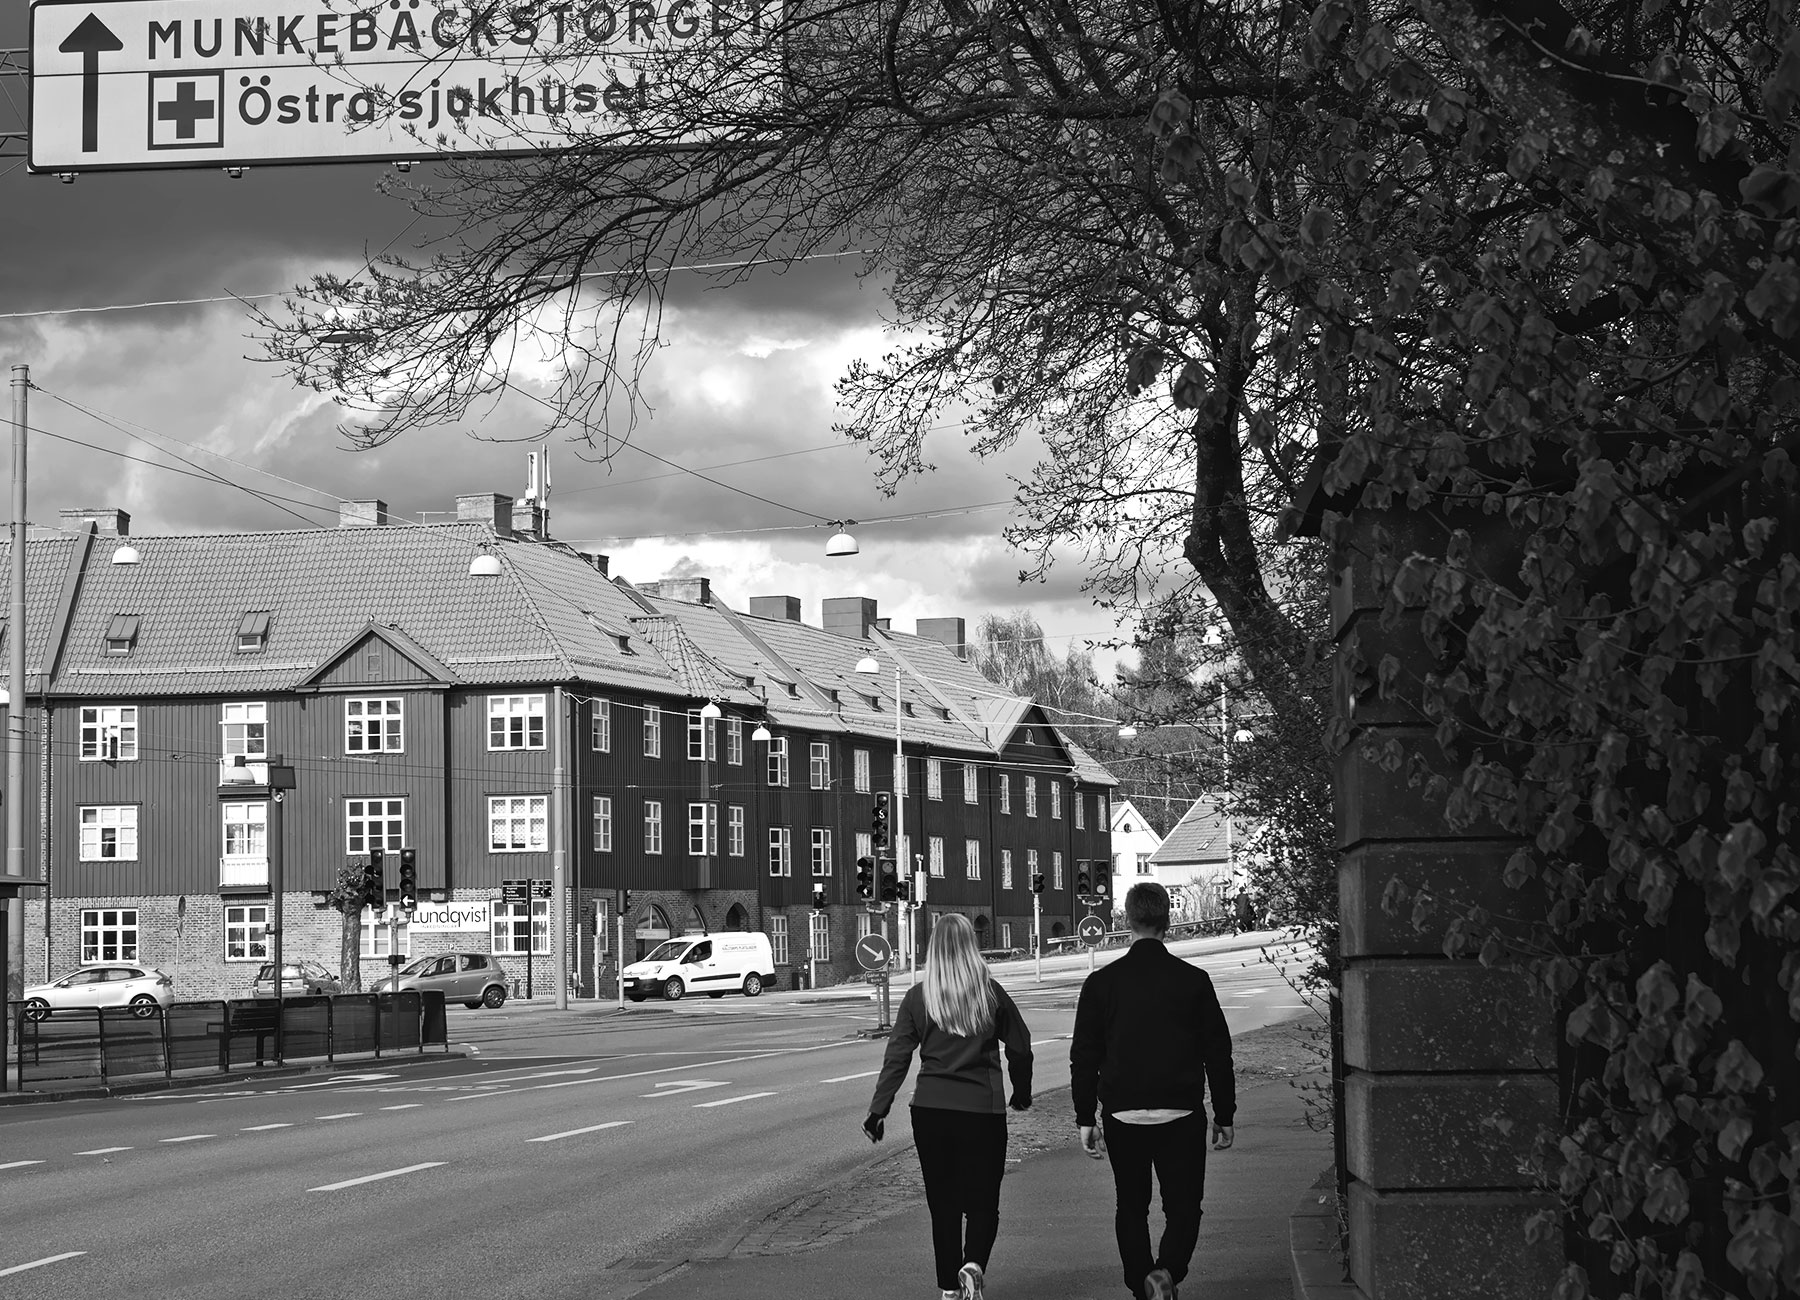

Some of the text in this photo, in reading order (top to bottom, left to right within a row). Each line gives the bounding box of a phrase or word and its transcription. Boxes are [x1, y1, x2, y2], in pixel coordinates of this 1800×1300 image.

[238, 72, 651, 129] Östra sjukhuset
[412, 905, 487, 928] Lundqvist
